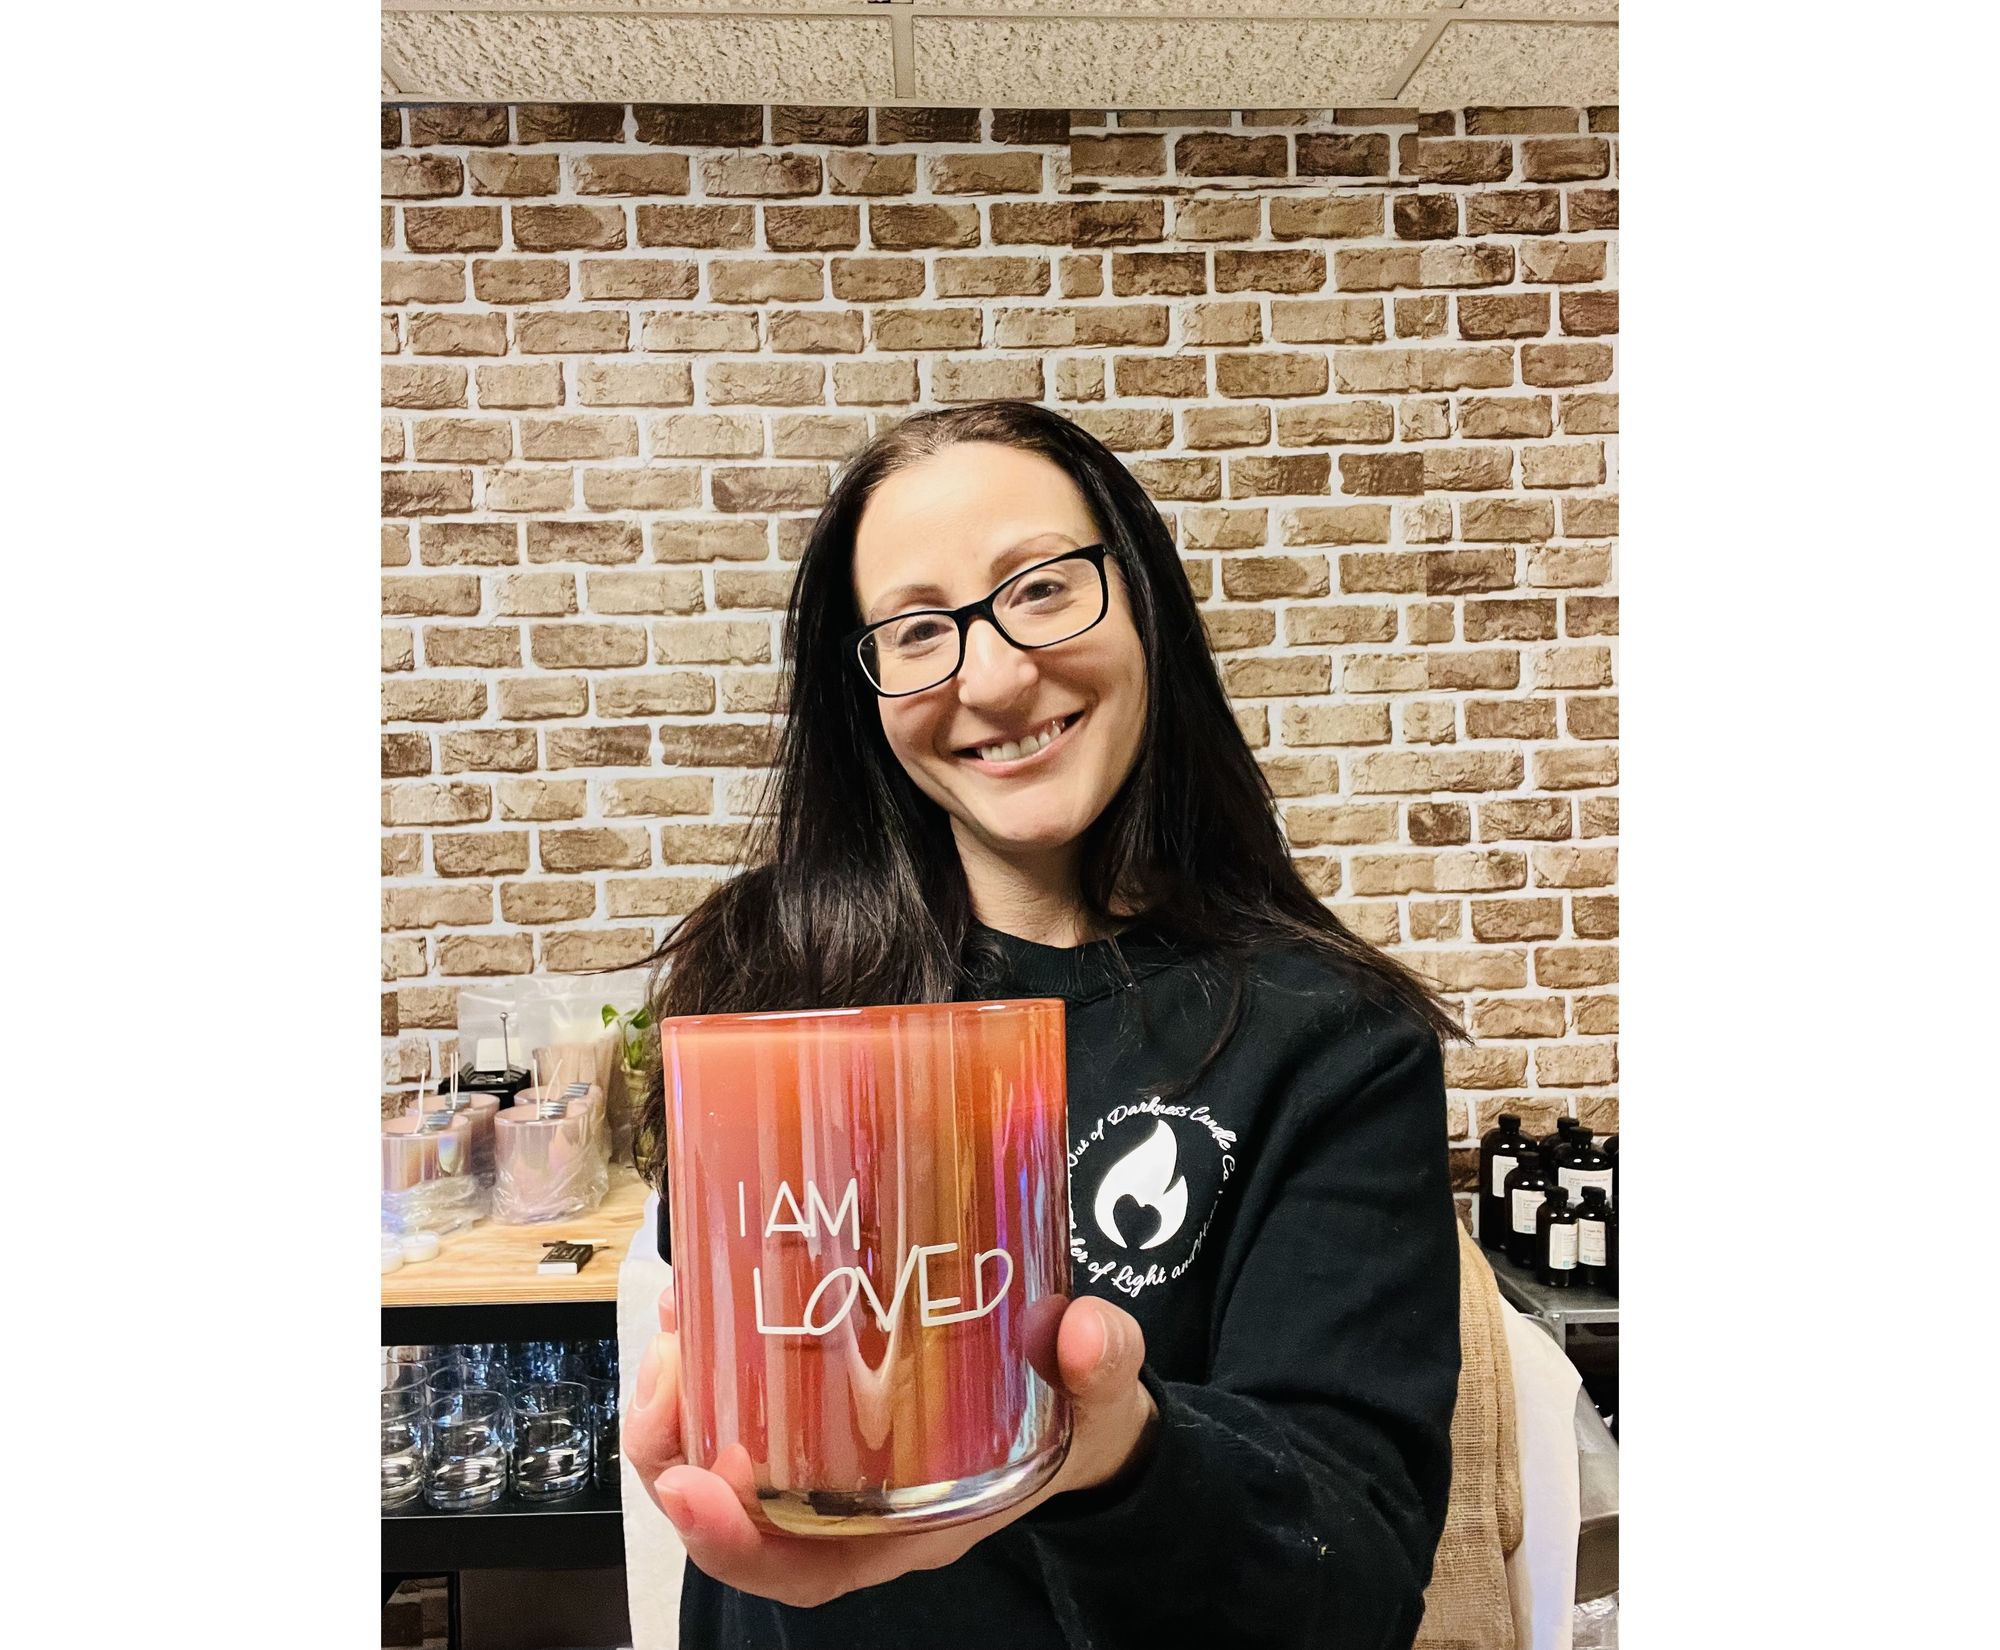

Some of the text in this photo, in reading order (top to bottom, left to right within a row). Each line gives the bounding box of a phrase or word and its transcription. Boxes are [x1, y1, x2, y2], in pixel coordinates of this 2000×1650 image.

[1091, 1118, 1105, 1141] of
[1106, 1096, 1191, 1126] Darkness
[1189, 1106, 1238, 1151] Candle
[738, 1177, 861, 1251] I AM
[753, 1242, 1014, 1336] LOVED
[1110, 1263, 1167, 1298] Light
